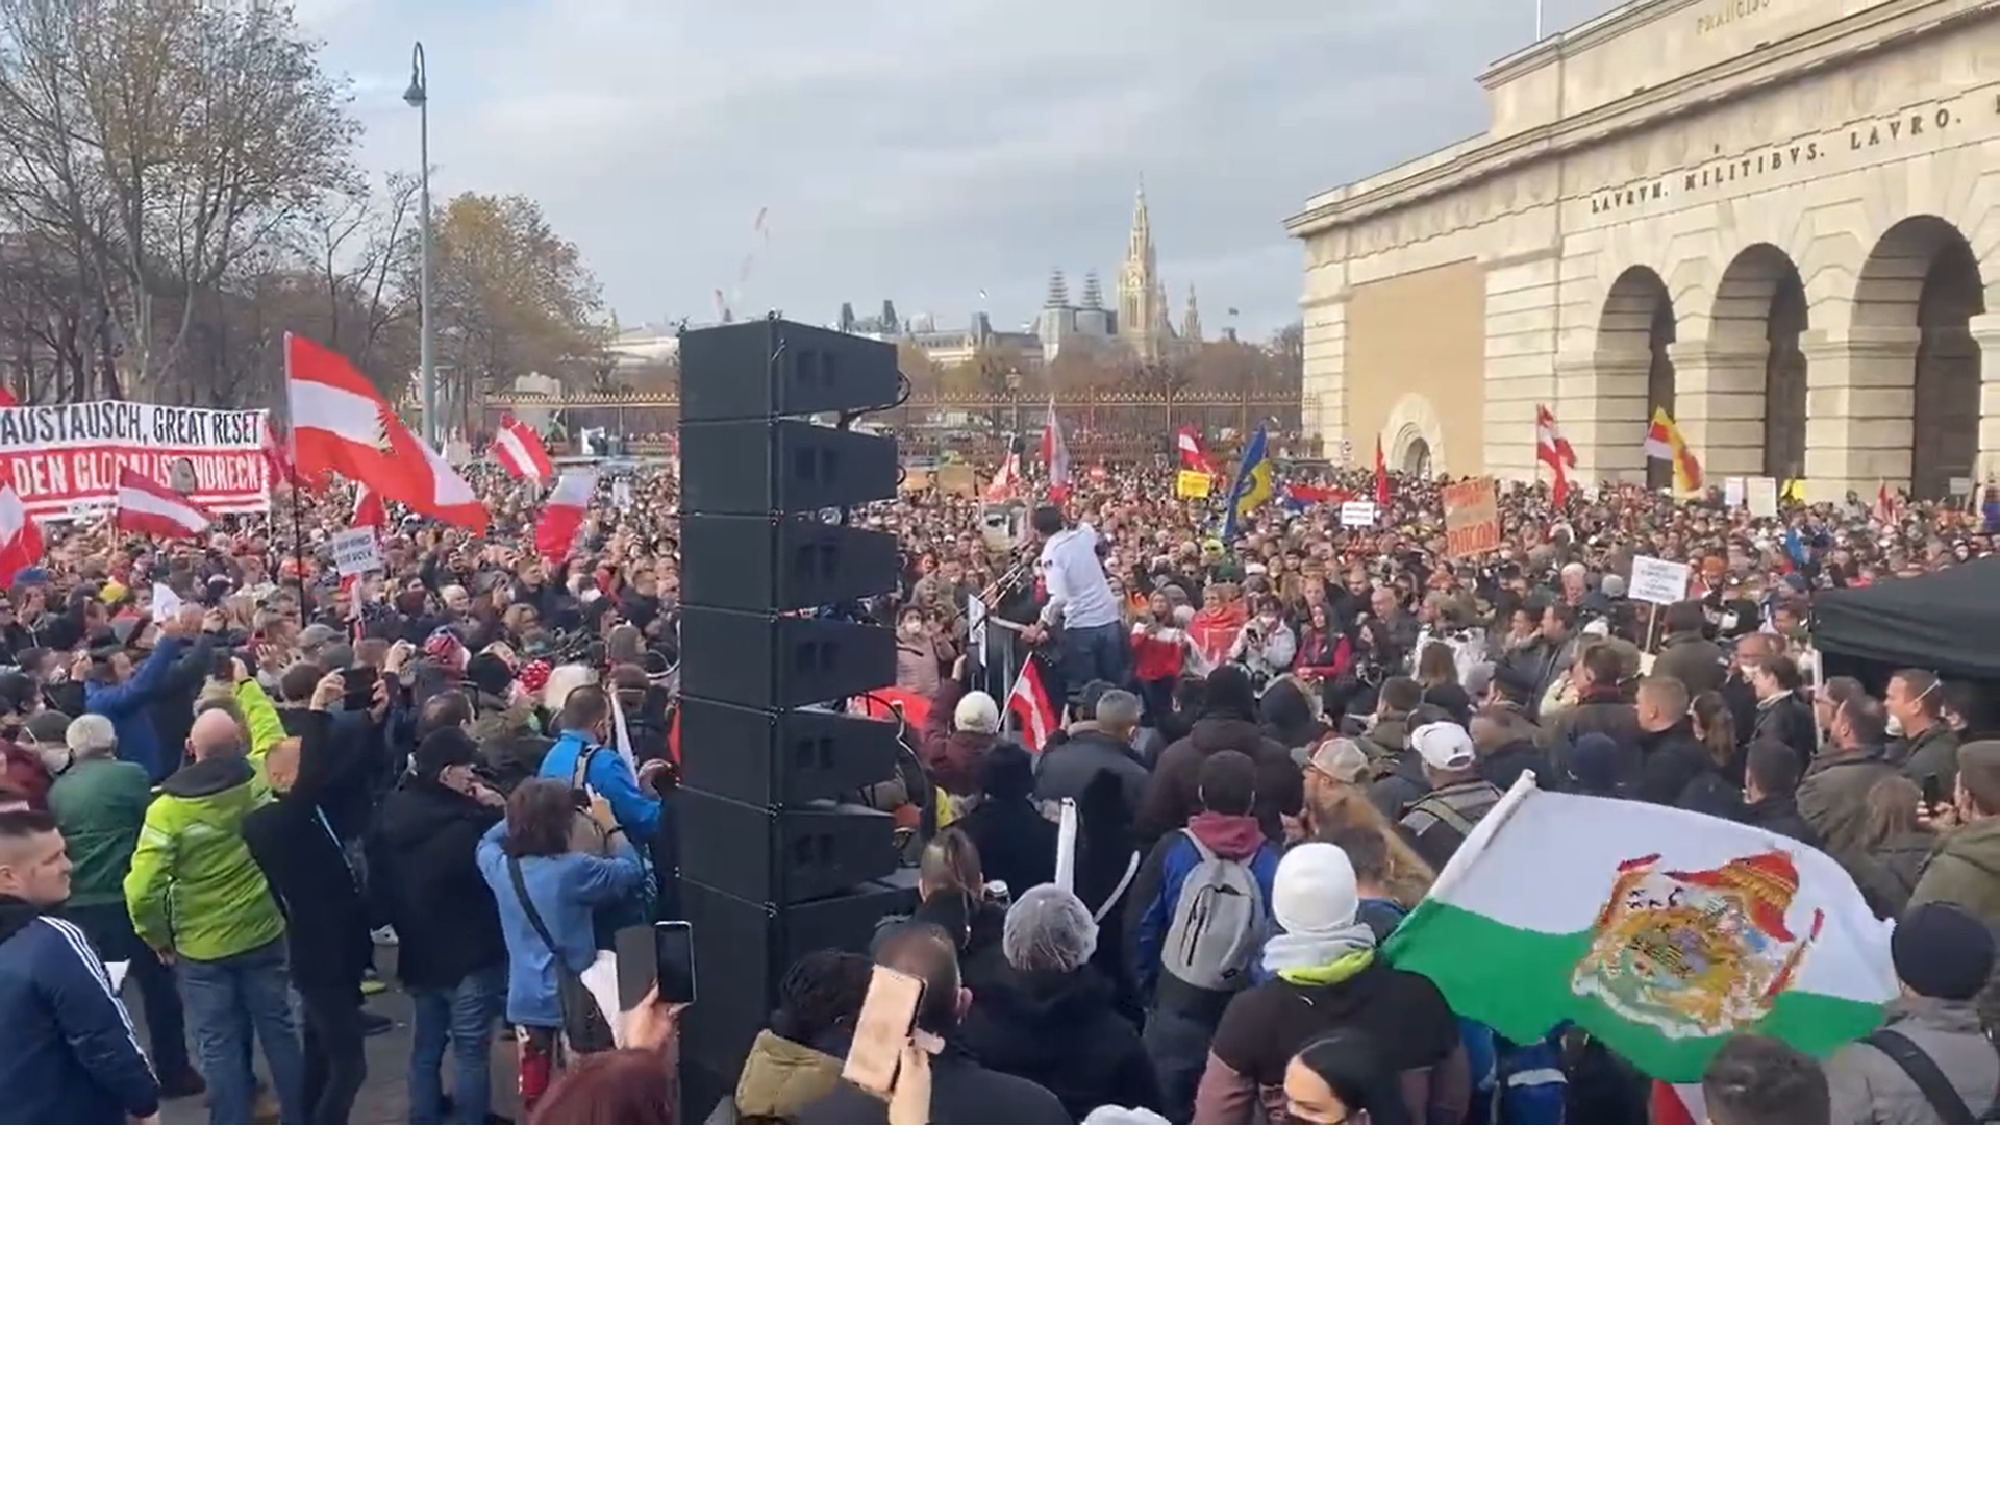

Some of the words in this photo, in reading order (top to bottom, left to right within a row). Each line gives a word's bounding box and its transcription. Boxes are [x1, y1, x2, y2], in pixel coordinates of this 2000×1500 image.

[1684, 143, 1826, 192] MILITIBVS.
[1850, 107, 1962, 151] LAVRO.
[1, 401, 148, 446] AUSTAUSCH,
[153, 406, 208, 445] GREAT
[213, 410, 259, 446] RESET
[11, 453, 69, 498] DEN
